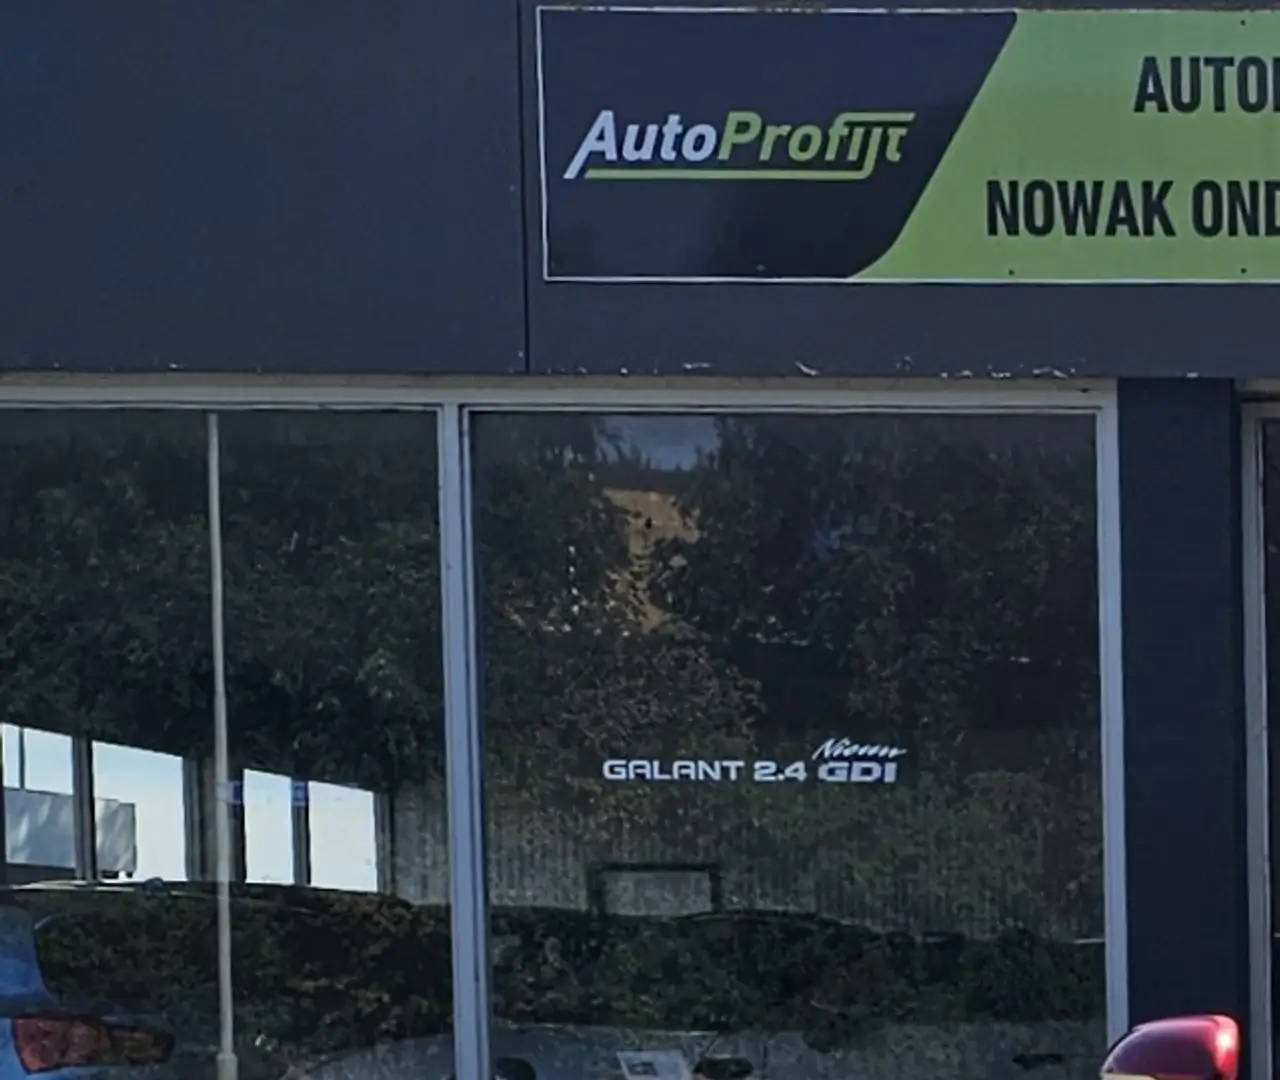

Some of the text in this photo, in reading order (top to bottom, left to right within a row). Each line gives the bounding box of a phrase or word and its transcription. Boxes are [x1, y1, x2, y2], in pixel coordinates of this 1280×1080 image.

[986, 178, 1176, 238] NOWAK
[602, 759, 898, 783] GALANT 2.4 GDI
